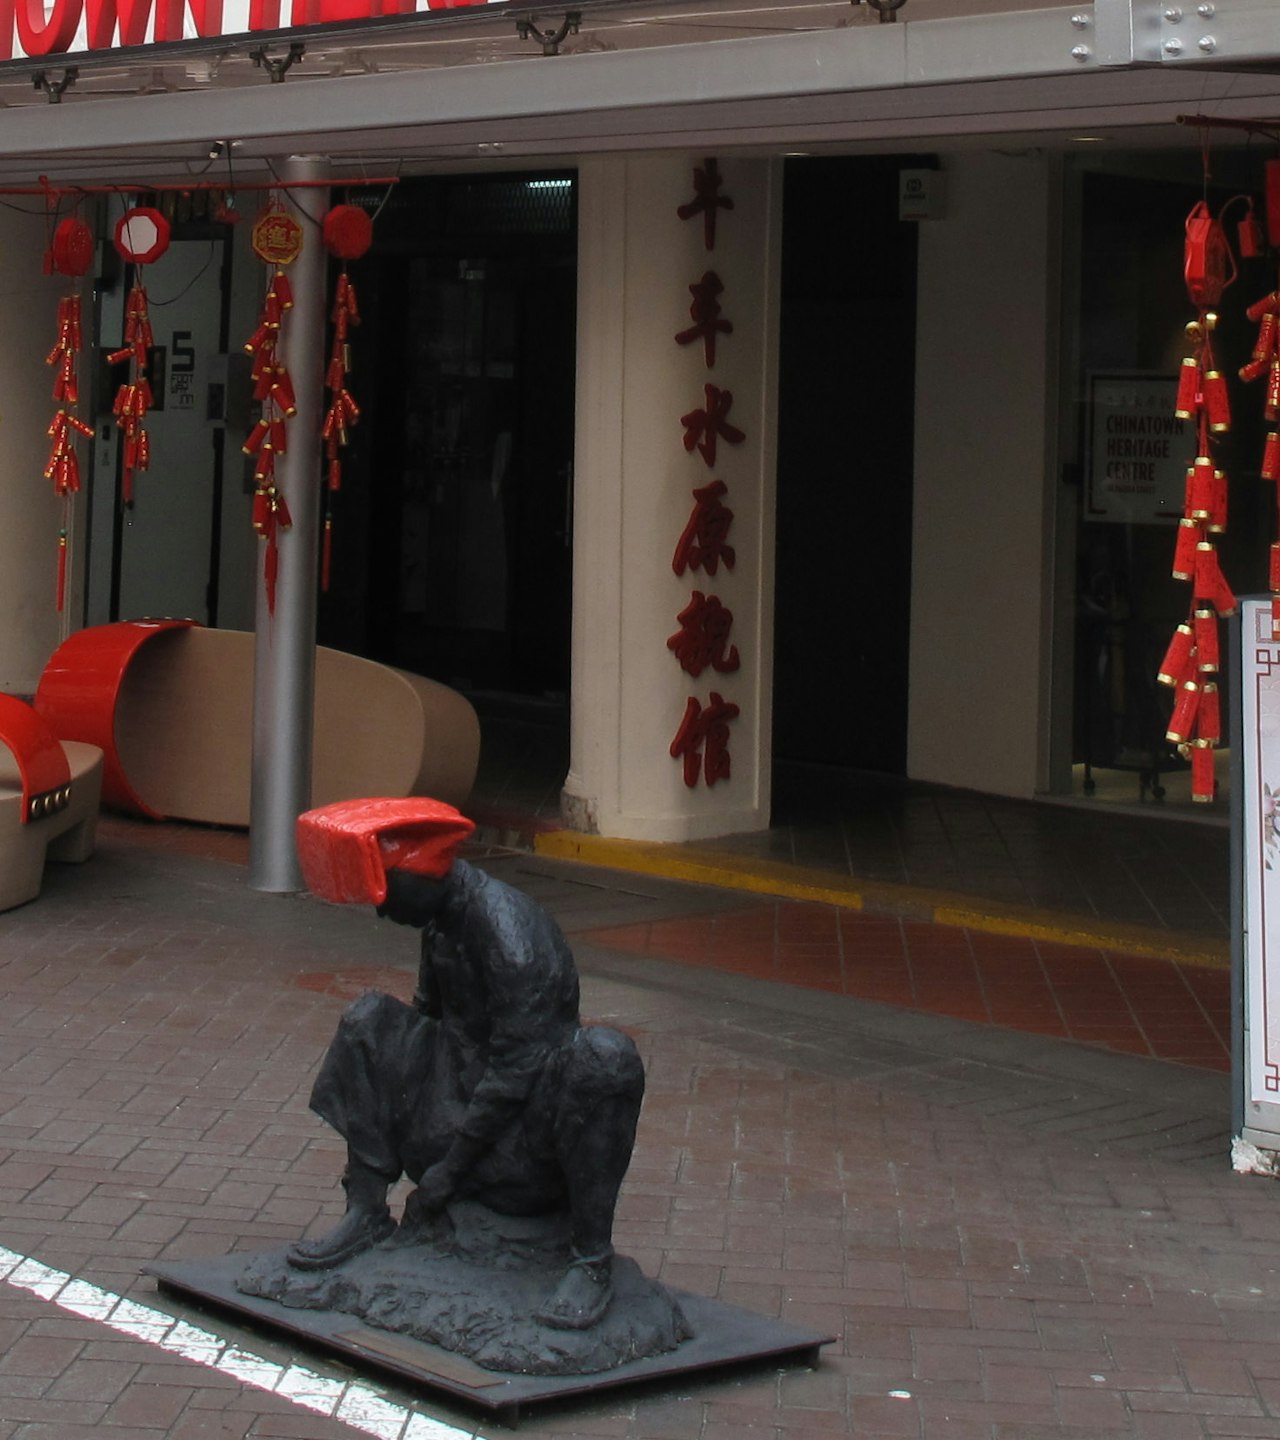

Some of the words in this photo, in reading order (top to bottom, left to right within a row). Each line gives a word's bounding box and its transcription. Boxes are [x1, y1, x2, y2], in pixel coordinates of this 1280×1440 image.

[172, 330, 195, 373] 5
[1106, 415, 1184, 436] CHINATOWN
[1107, 438, 1170, 459] HERITAGE
[667, 158, 747, 788] 牛车水原貌馆
[1106, 462, 1155, 481] CENTRE
